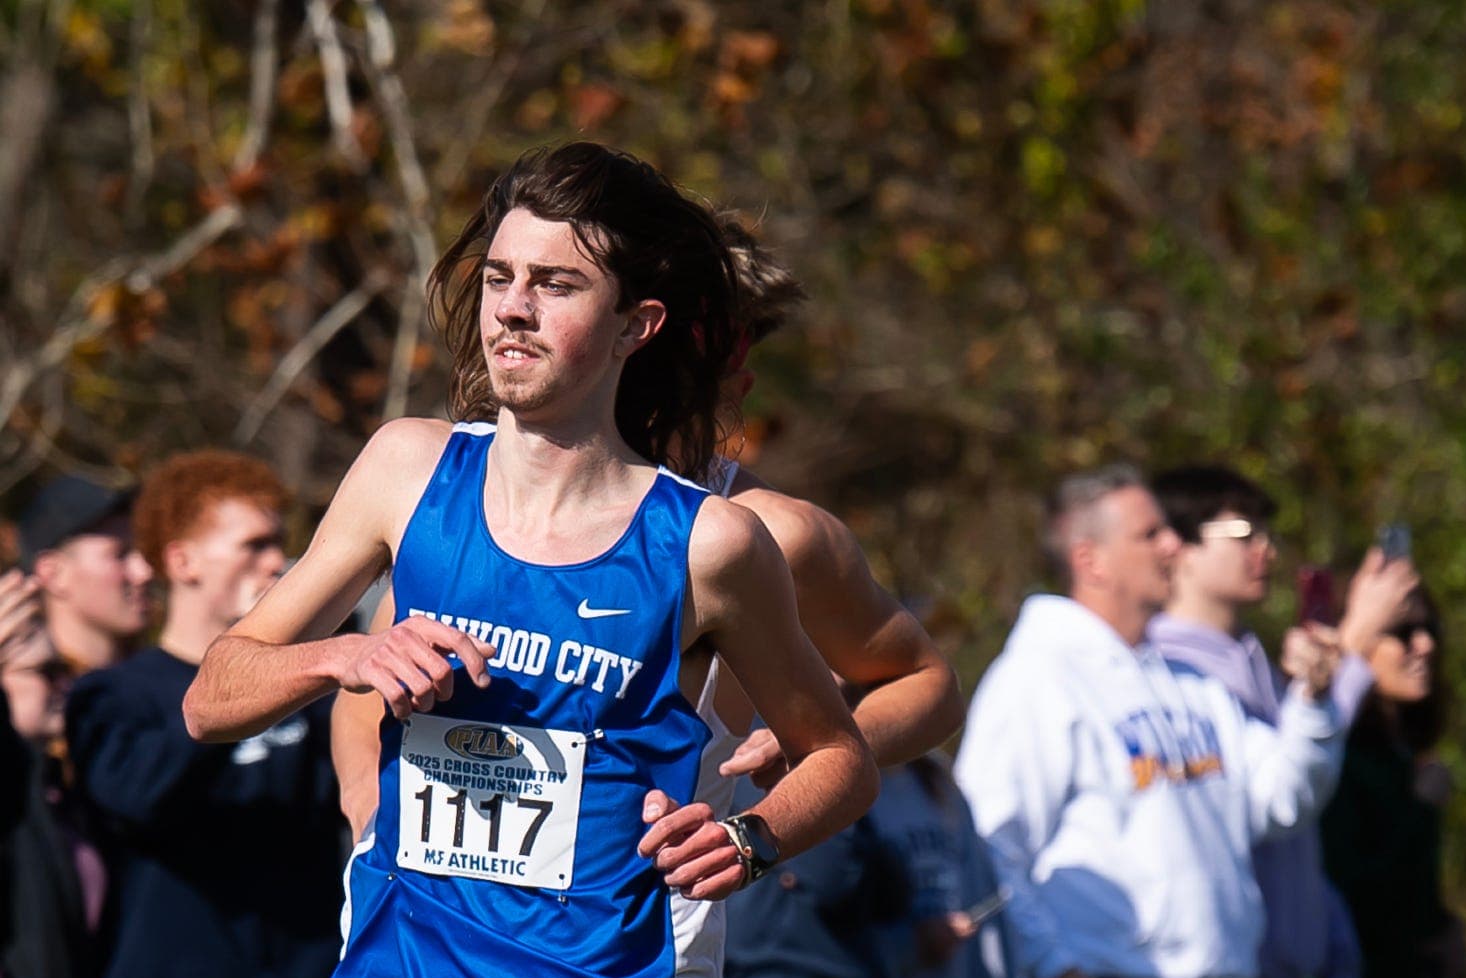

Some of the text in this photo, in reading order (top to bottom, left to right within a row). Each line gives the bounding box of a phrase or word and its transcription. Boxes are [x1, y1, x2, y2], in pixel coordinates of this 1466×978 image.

[555, 639, 643, 699] CITY
[454, 728, 518, 757] PIAA
[408, 753, 568, 784] 2025 CROSS COUNTRY
[423, 769, 543, 795] CHAMPIONSHIPS
[415, 785, 554, 857] 1117
[448, 852, 526, 876] ATHLETIC
